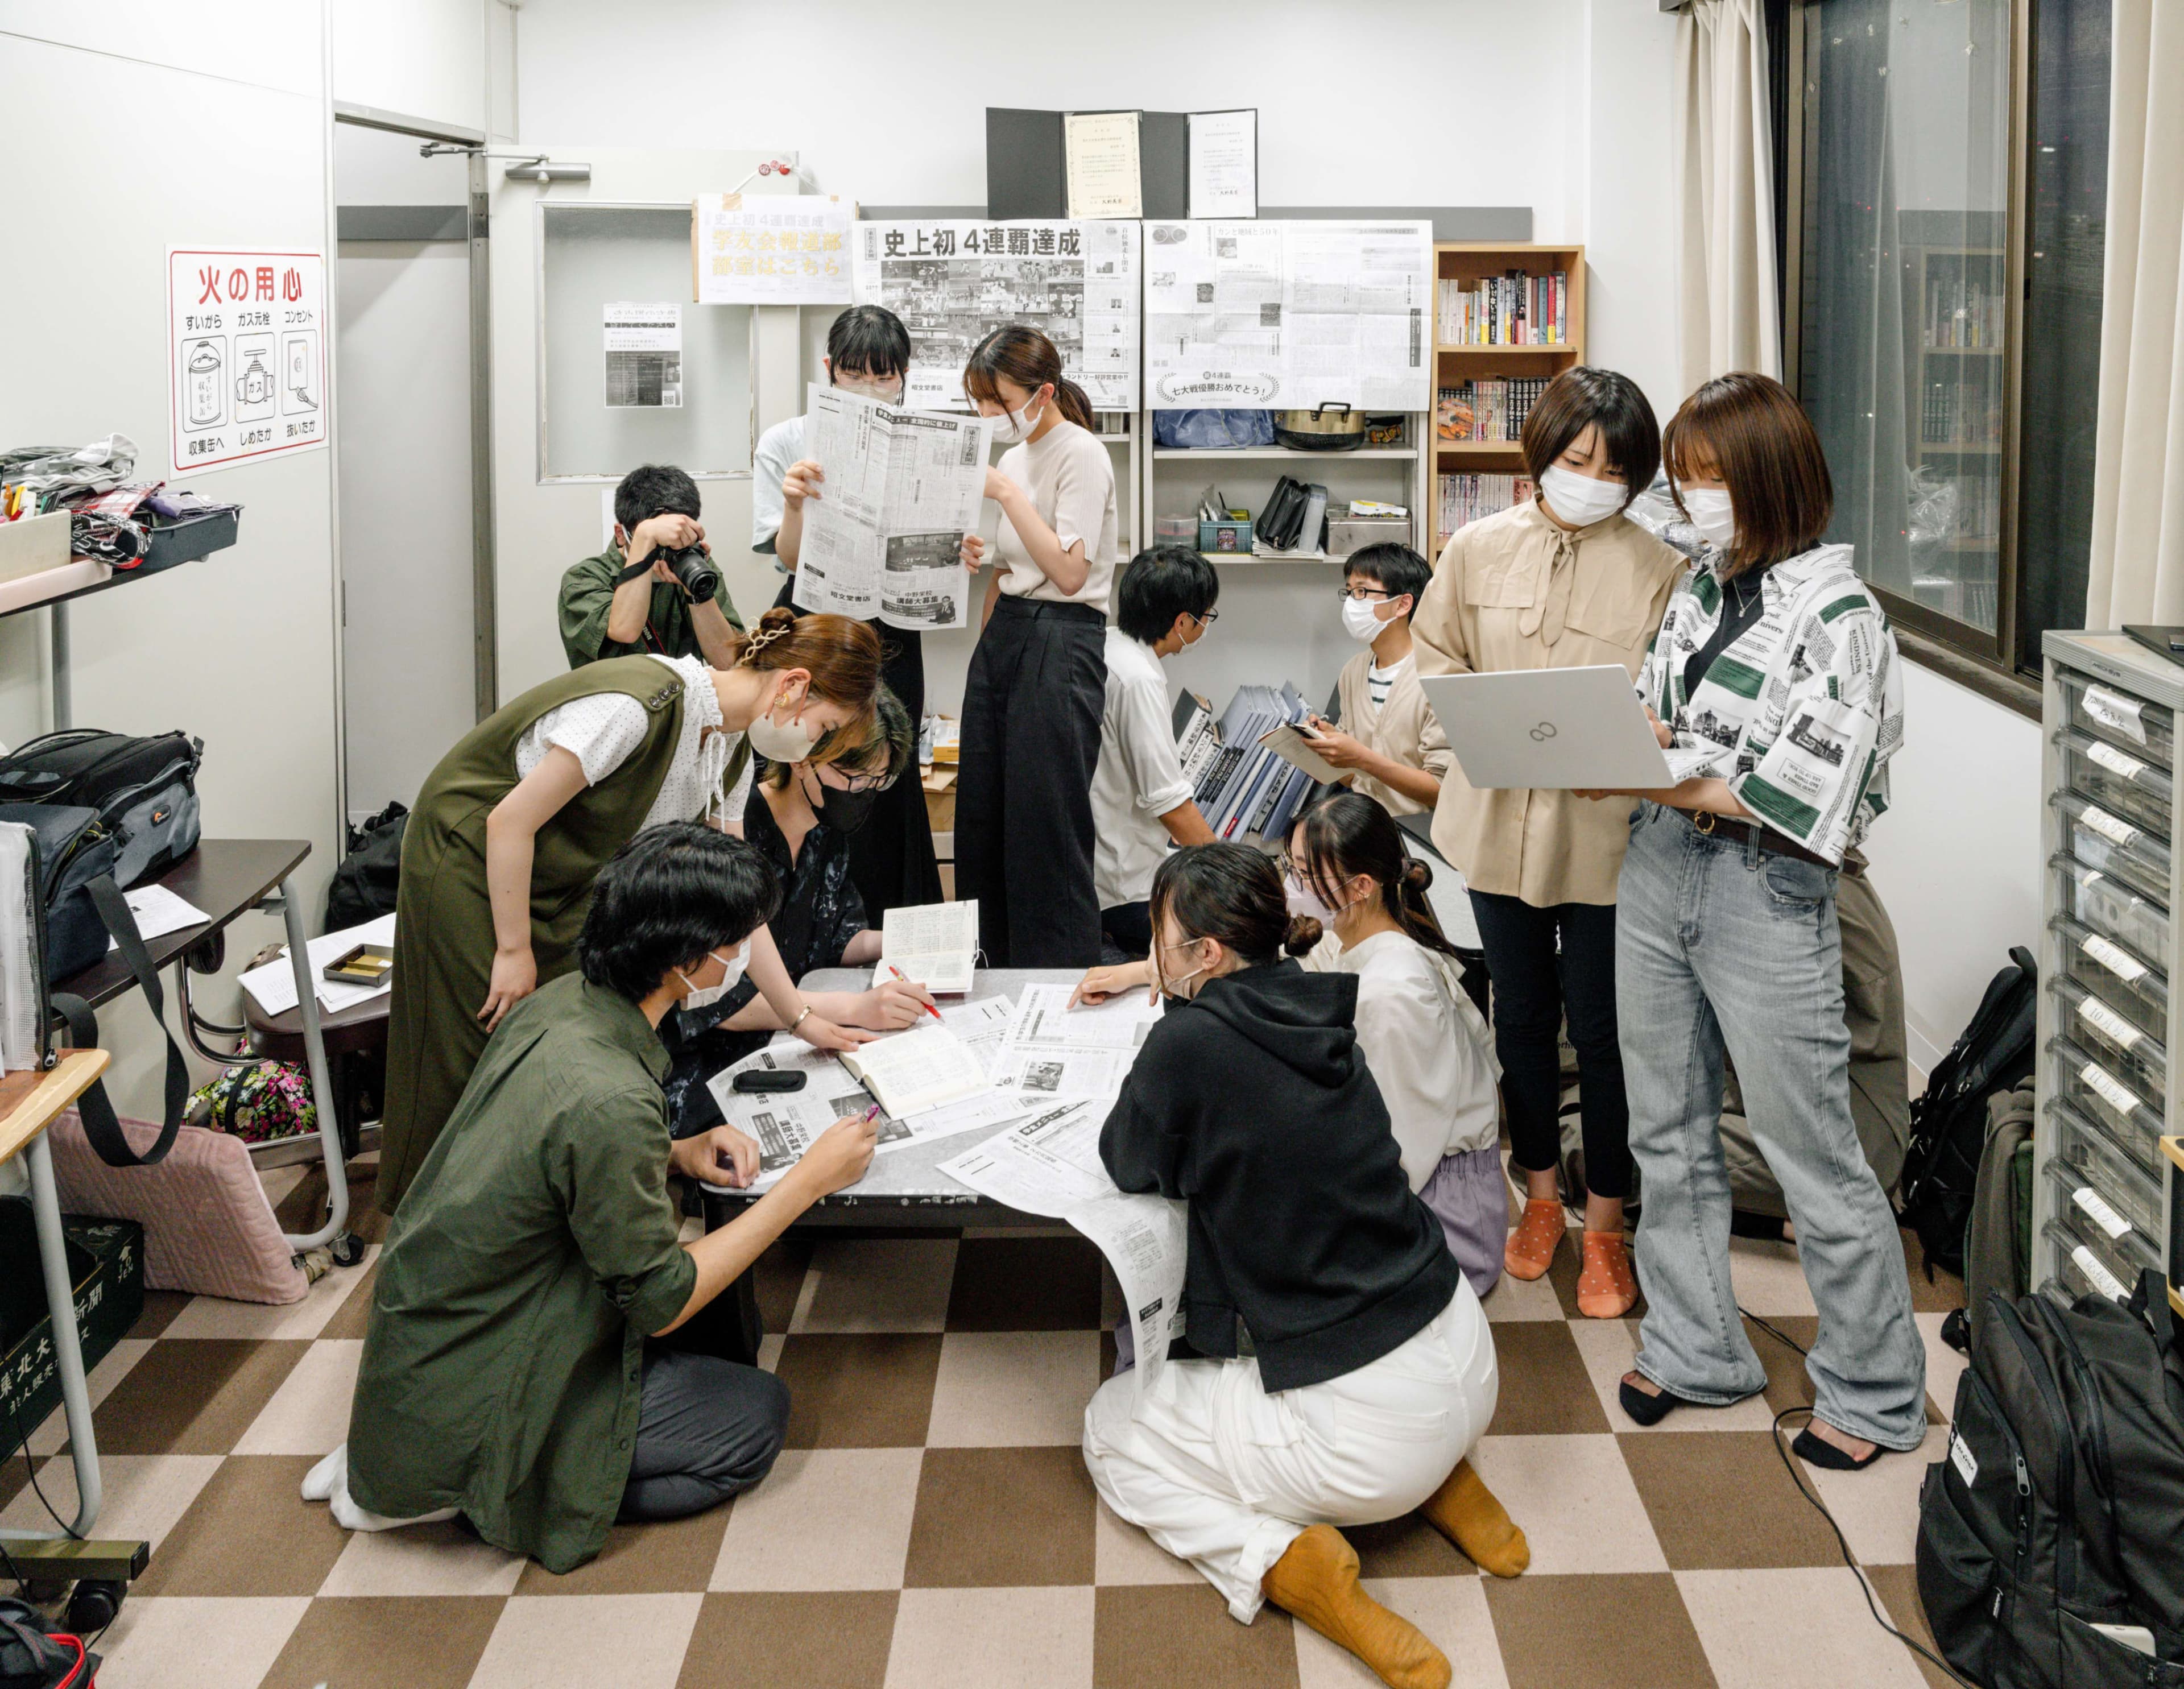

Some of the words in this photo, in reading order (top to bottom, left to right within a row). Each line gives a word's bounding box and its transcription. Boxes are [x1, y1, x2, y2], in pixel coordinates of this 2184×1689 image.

[713, 230, 842, 251] 学友会報道部
[713, 254, 839, 276] 部室はこちら
[198, 264, 303, 305] 火の用心
[185, 314, 222, 330] すいがら
[238, 312, 271, 327] ガス元栓
[284, 309, 313, 324] コンセント
[249, 382, 262, 394] ガス
[240, 428, 272, 446] しめたか
[287, 420, 316, 438] 抜いたか
[189, 438, 225, 457] 収集缶へ
[1852, 629, 1861, 674] KINDNESS
[1788, 777, 1802, 788] TIMES
[1794, 774, 1809, 784] TIMES
[1802, 785, 1816, 794] GOOD
[2089, 1007, 2125, 1038] 10月号
[118, 1263, 134, 1284] YEN
